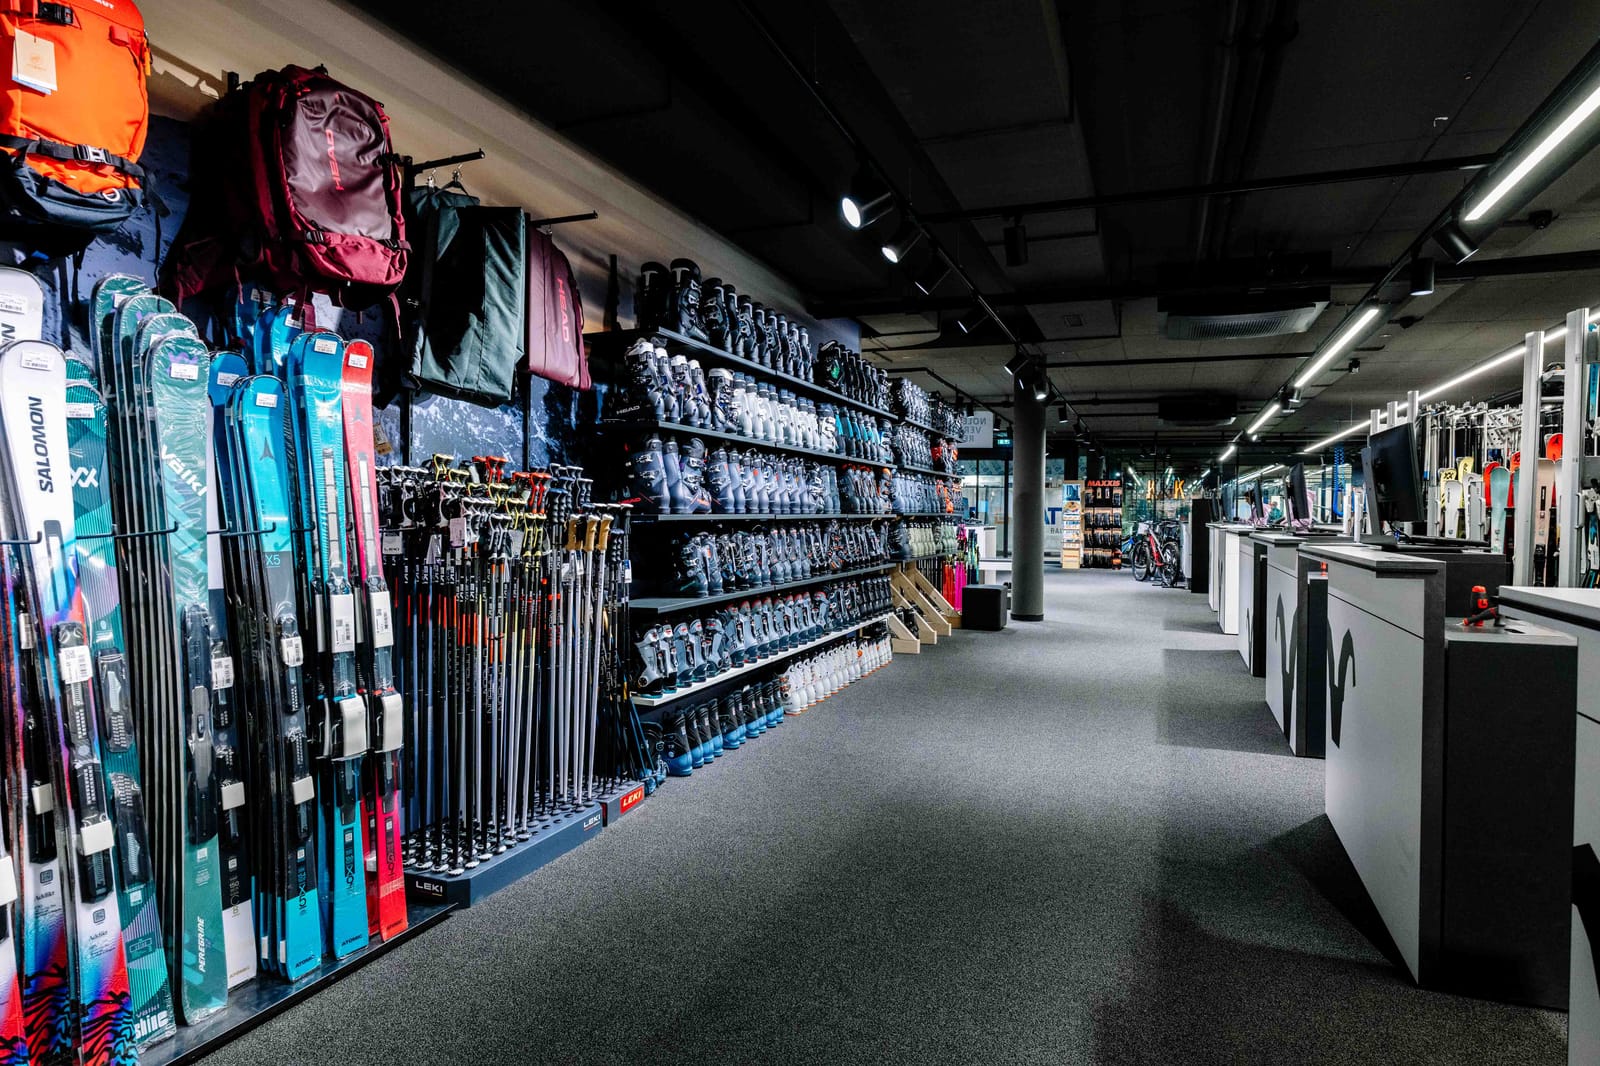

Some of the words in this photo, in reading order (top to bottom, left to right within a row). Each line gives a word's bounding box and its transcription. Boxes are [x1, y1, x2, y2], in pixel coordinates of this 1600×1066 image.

[325, 129, 344, 190] HEAD
[557, 277, 570, 342] HEAD
[28, 396, 54, 493] SALOMON
[264, 554, 281, 566] X5
[622, 790, 642, 806] LEKI
[583, 814, 601, 828] LEKI
[415, 881, 443, 893] LEKI
[197, 916, 206, 973] PEREGRINE
